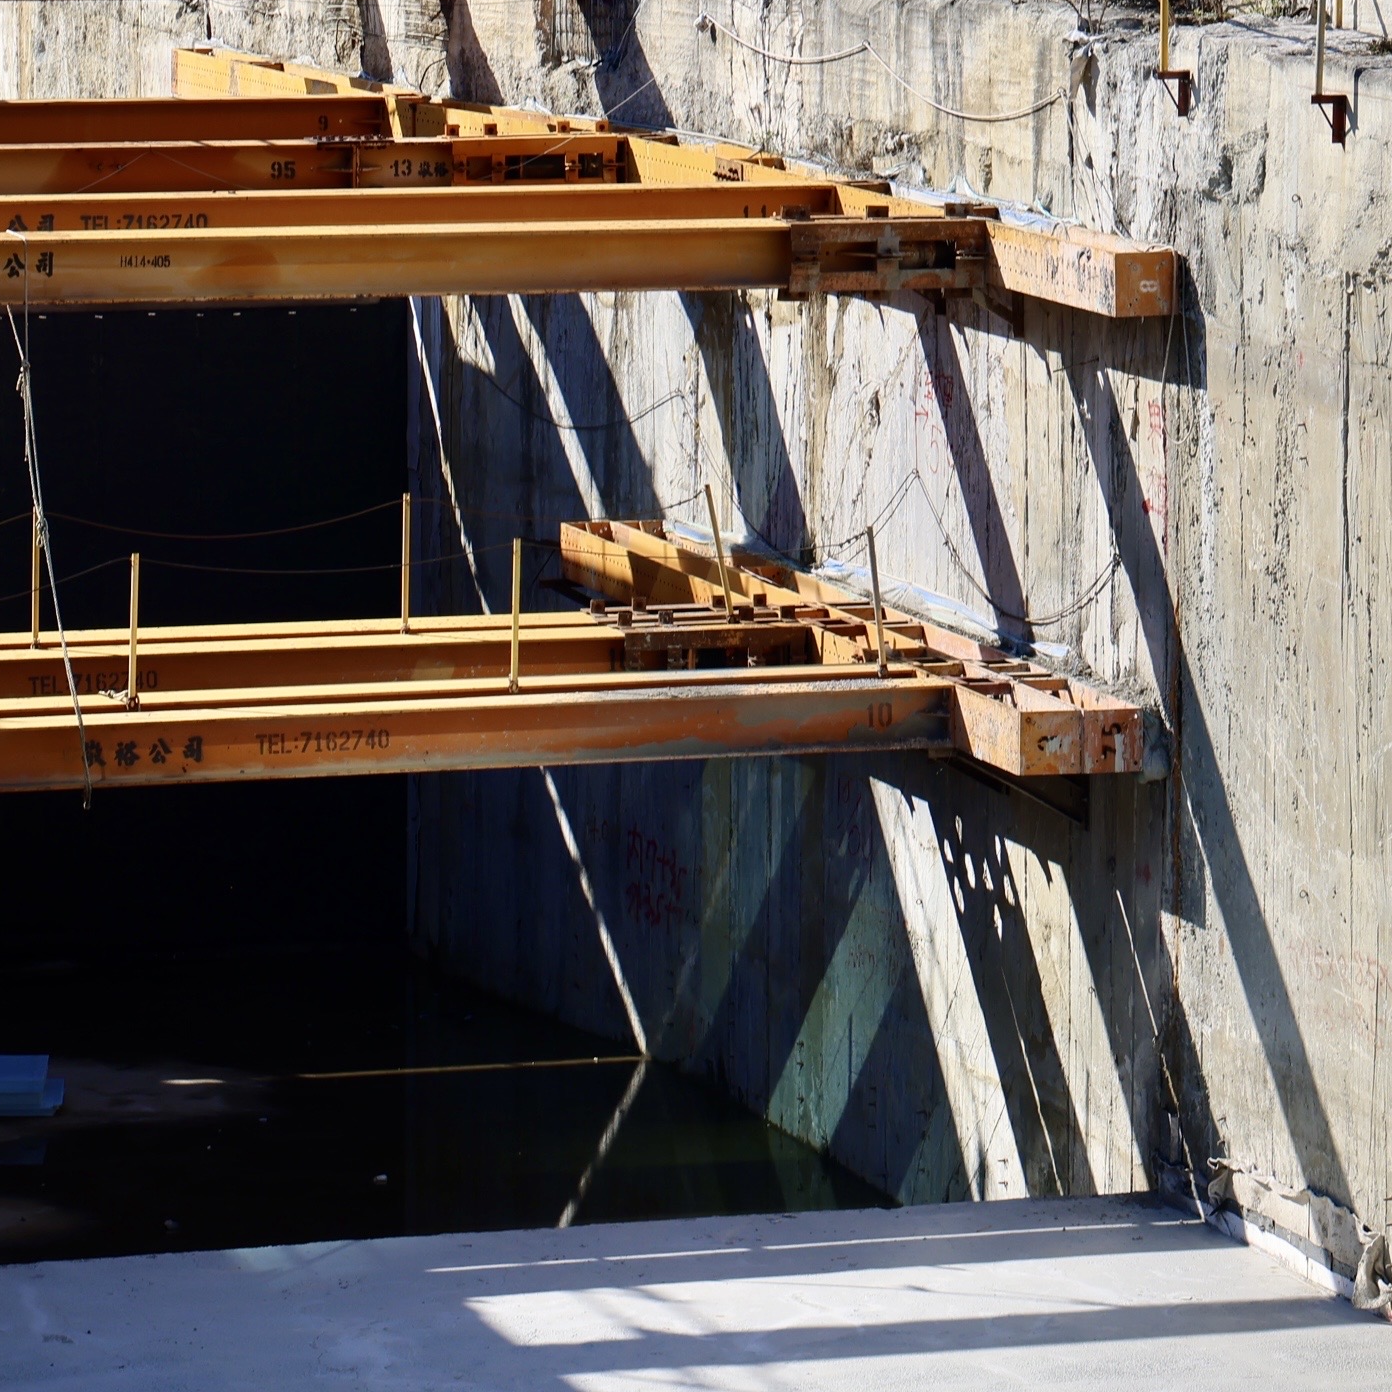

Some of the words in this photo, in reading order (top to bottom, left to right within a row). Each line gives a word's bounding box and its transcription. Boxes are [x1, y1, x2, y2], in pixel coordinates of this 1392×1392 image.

[318, 115, 329, 131] 9
[270, 160, 296, 180] 95
[865, 702, 893, 728] 10
[83, 735, 204, 768] 敬裕公司
[255, 729, 391, 756] TEL:7162740
